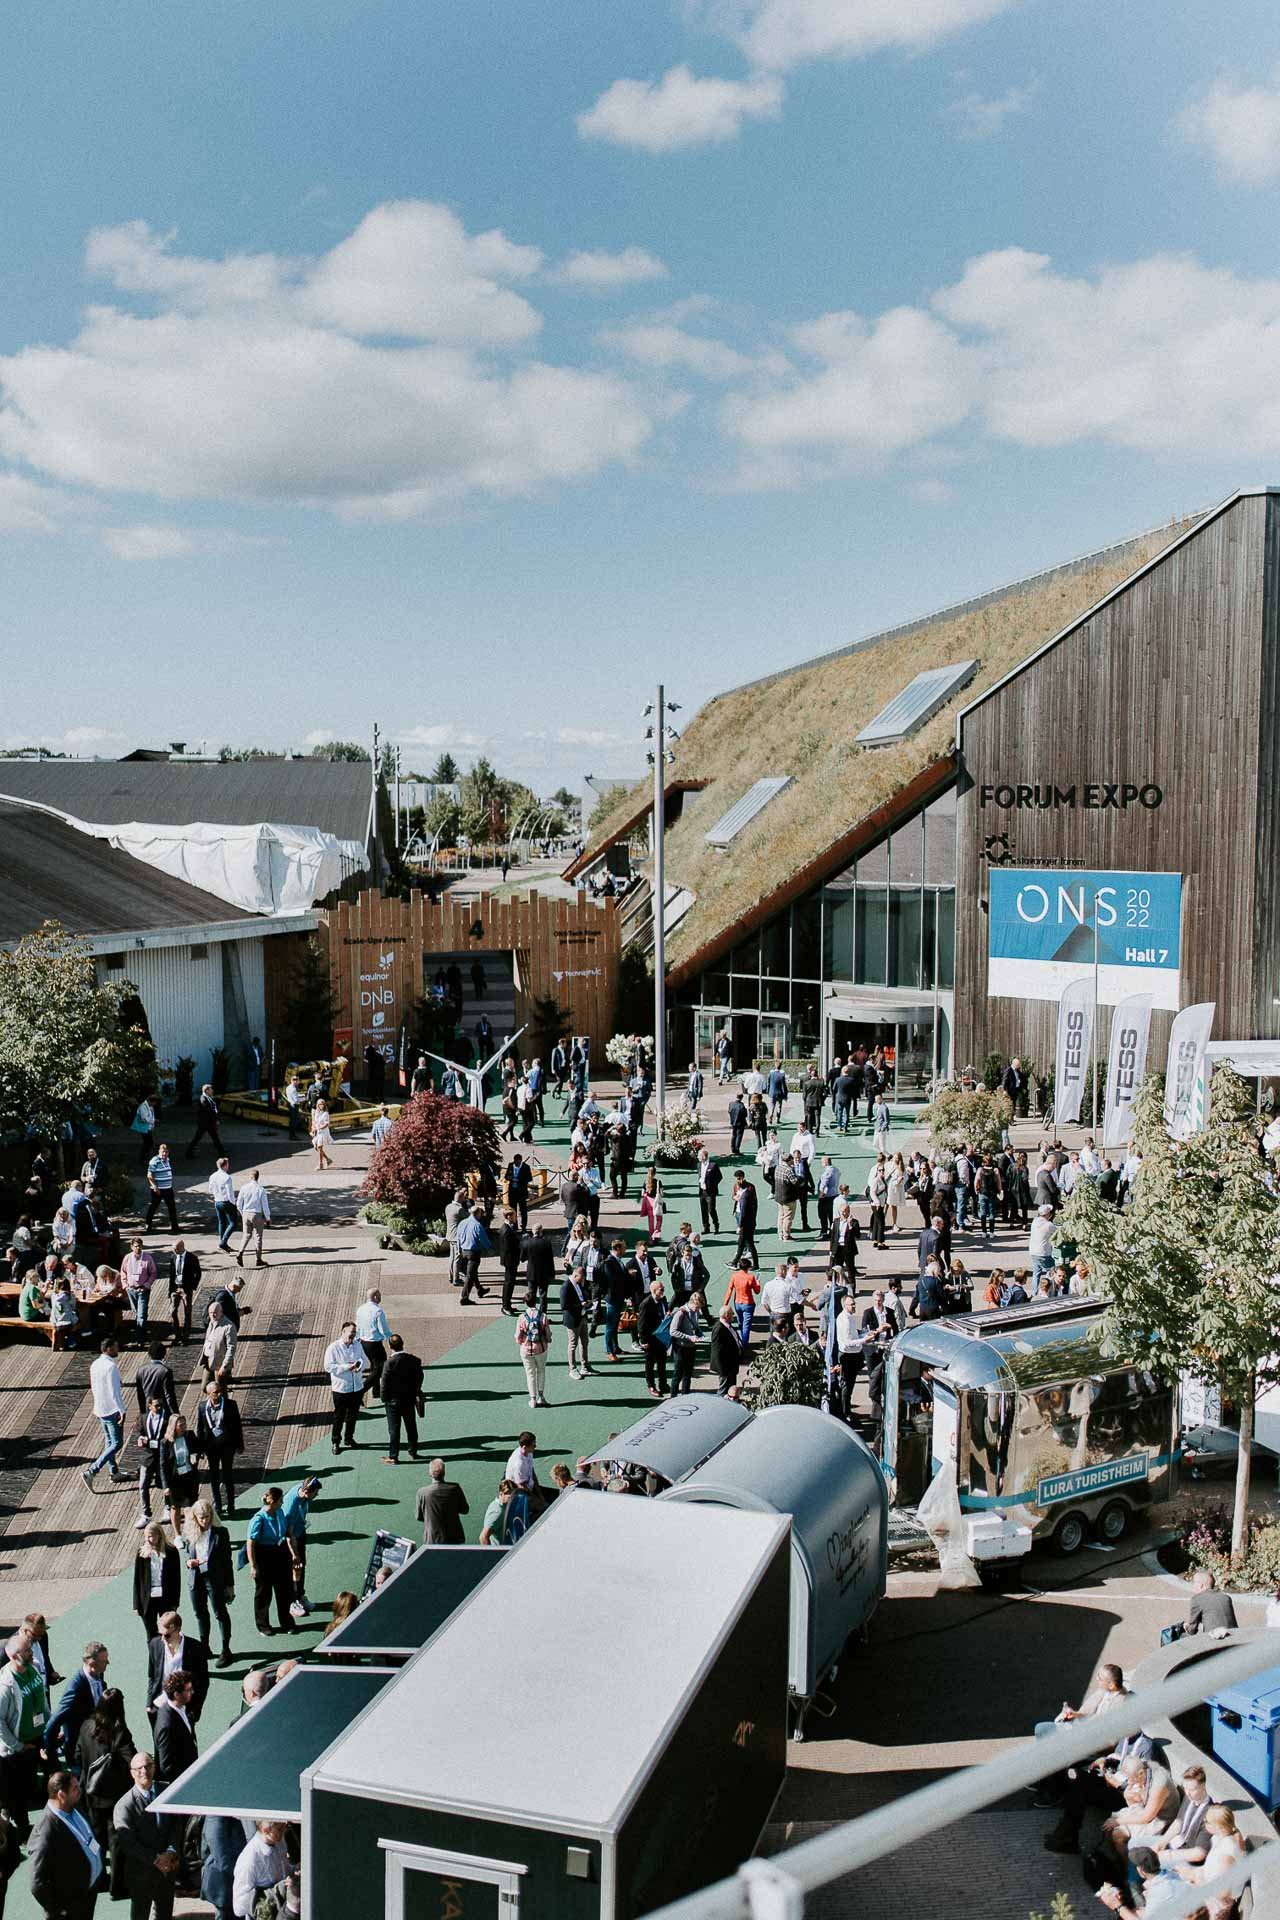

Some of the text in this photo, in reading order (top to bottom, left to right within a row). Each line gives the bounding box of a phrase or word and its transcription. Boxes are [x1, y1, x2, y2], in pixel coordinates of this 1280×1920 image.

[980, 783, 1163, 810] FORUM EXPO
[1017, 857, 1086, 867] stavanger forum
[1017, 884, 1118, 926] ONS
[1126, 889, 1150, 908] 20
[469, 919, 485, 940] 4
[1126, 909, 1150, 928] 22
[1125, 948, 1169, 964] Hall 7
[360, 973, 390, 983] equinor
[361, 986, 395, 1012] DNB
[1064, 1011, 1084, 1087] TESS
[1115, 1028, 1138, 1107] TESS
[1043, 1460, 1144, 1498] LURA TURISTHEIM
